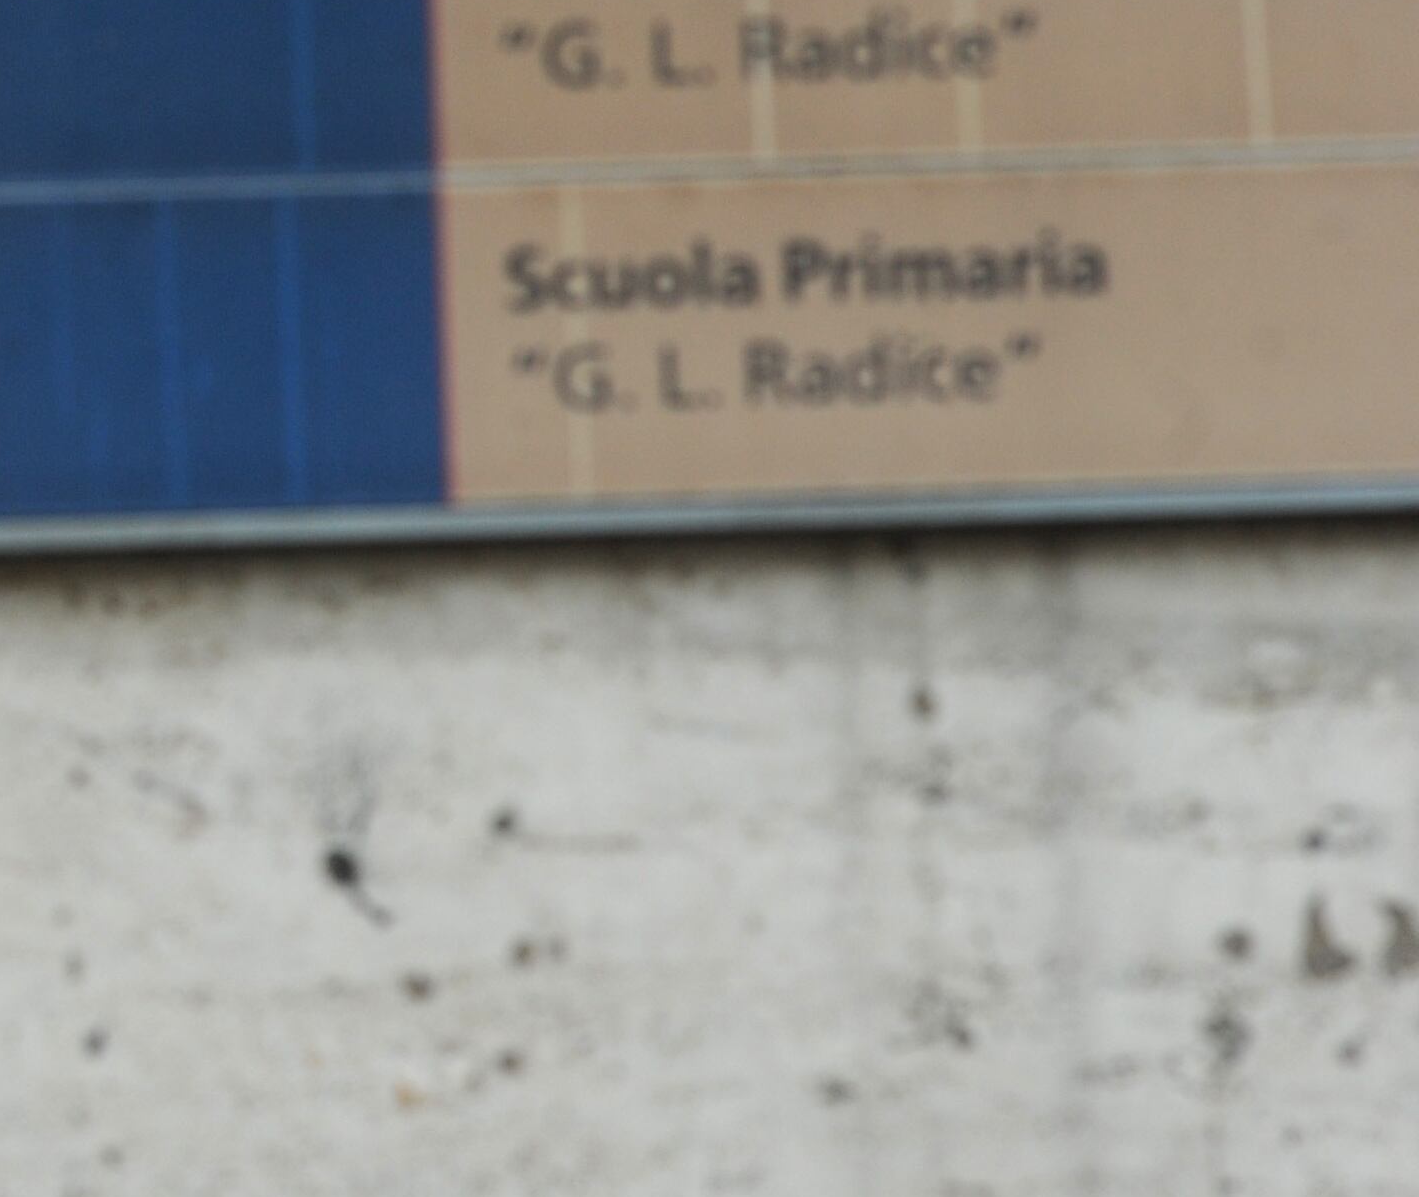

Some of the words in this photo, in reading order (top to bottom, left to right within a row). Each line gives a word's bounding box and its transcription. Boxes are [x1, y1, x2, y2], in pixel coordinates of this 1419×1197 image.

[649, 17, 718, 88] L.
[503, 239, 760, 314] Scuola
[780, 227, 1109, 301] Primaria
[657, 340, 725, 411] L.
